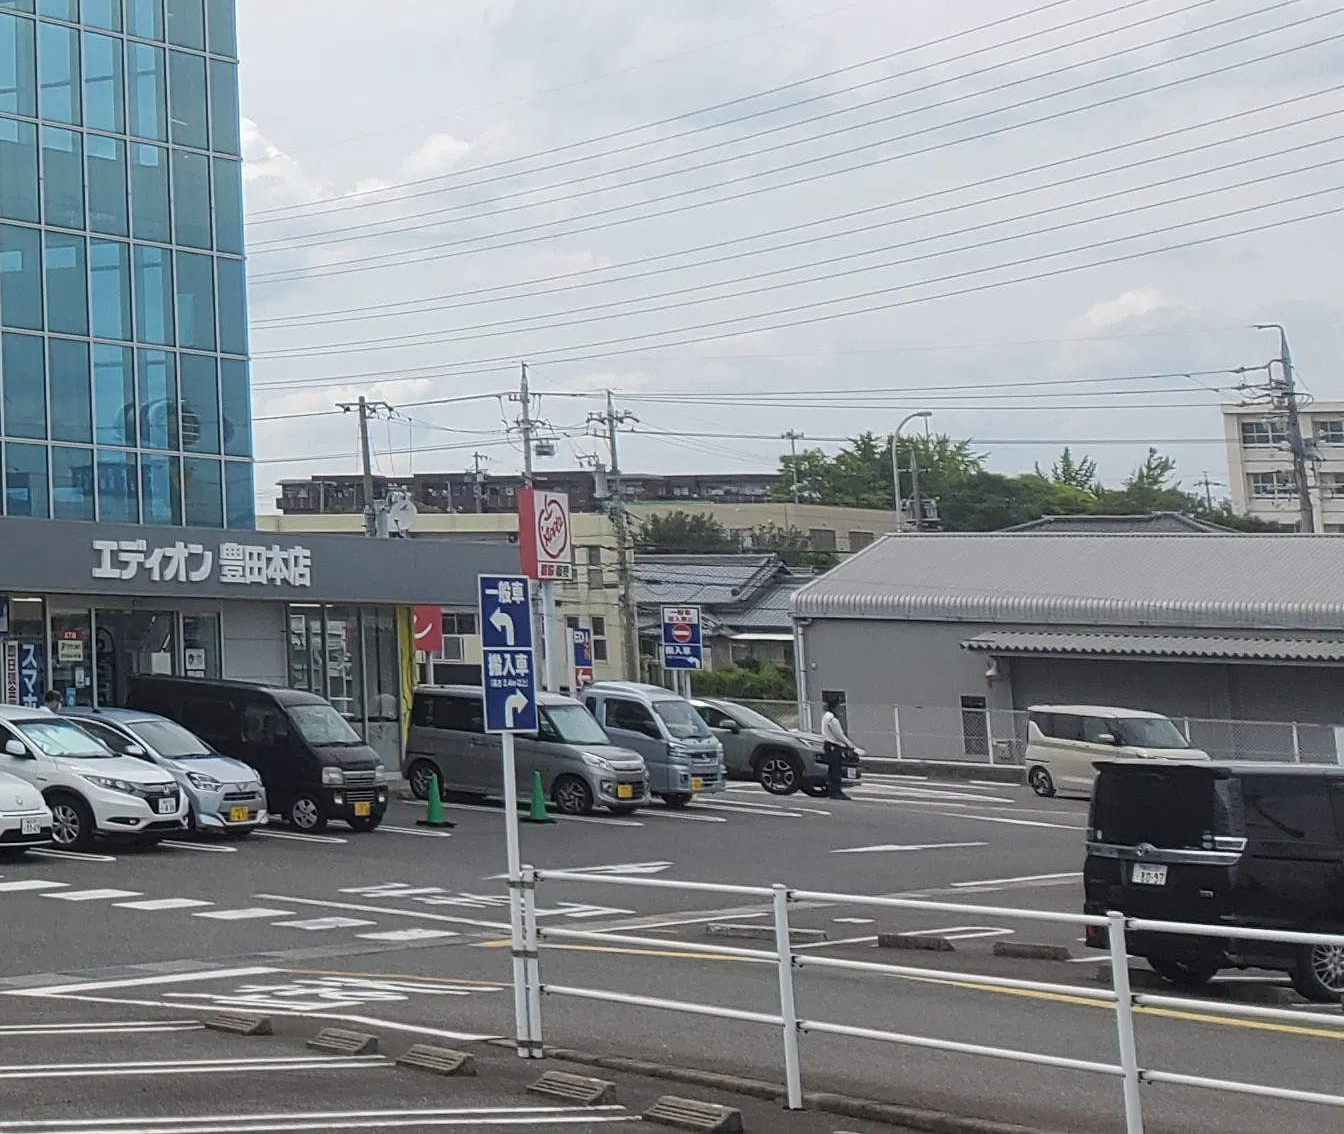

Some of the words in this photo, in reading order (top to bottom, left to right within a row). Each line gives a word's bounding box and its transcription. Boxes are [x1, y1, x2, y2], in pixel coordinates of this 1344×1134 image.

[92, 539, 212, 582] エディオン
[218, 542, 311, 587] 豊田本店
[485, 580, 525, 604] 一般車
